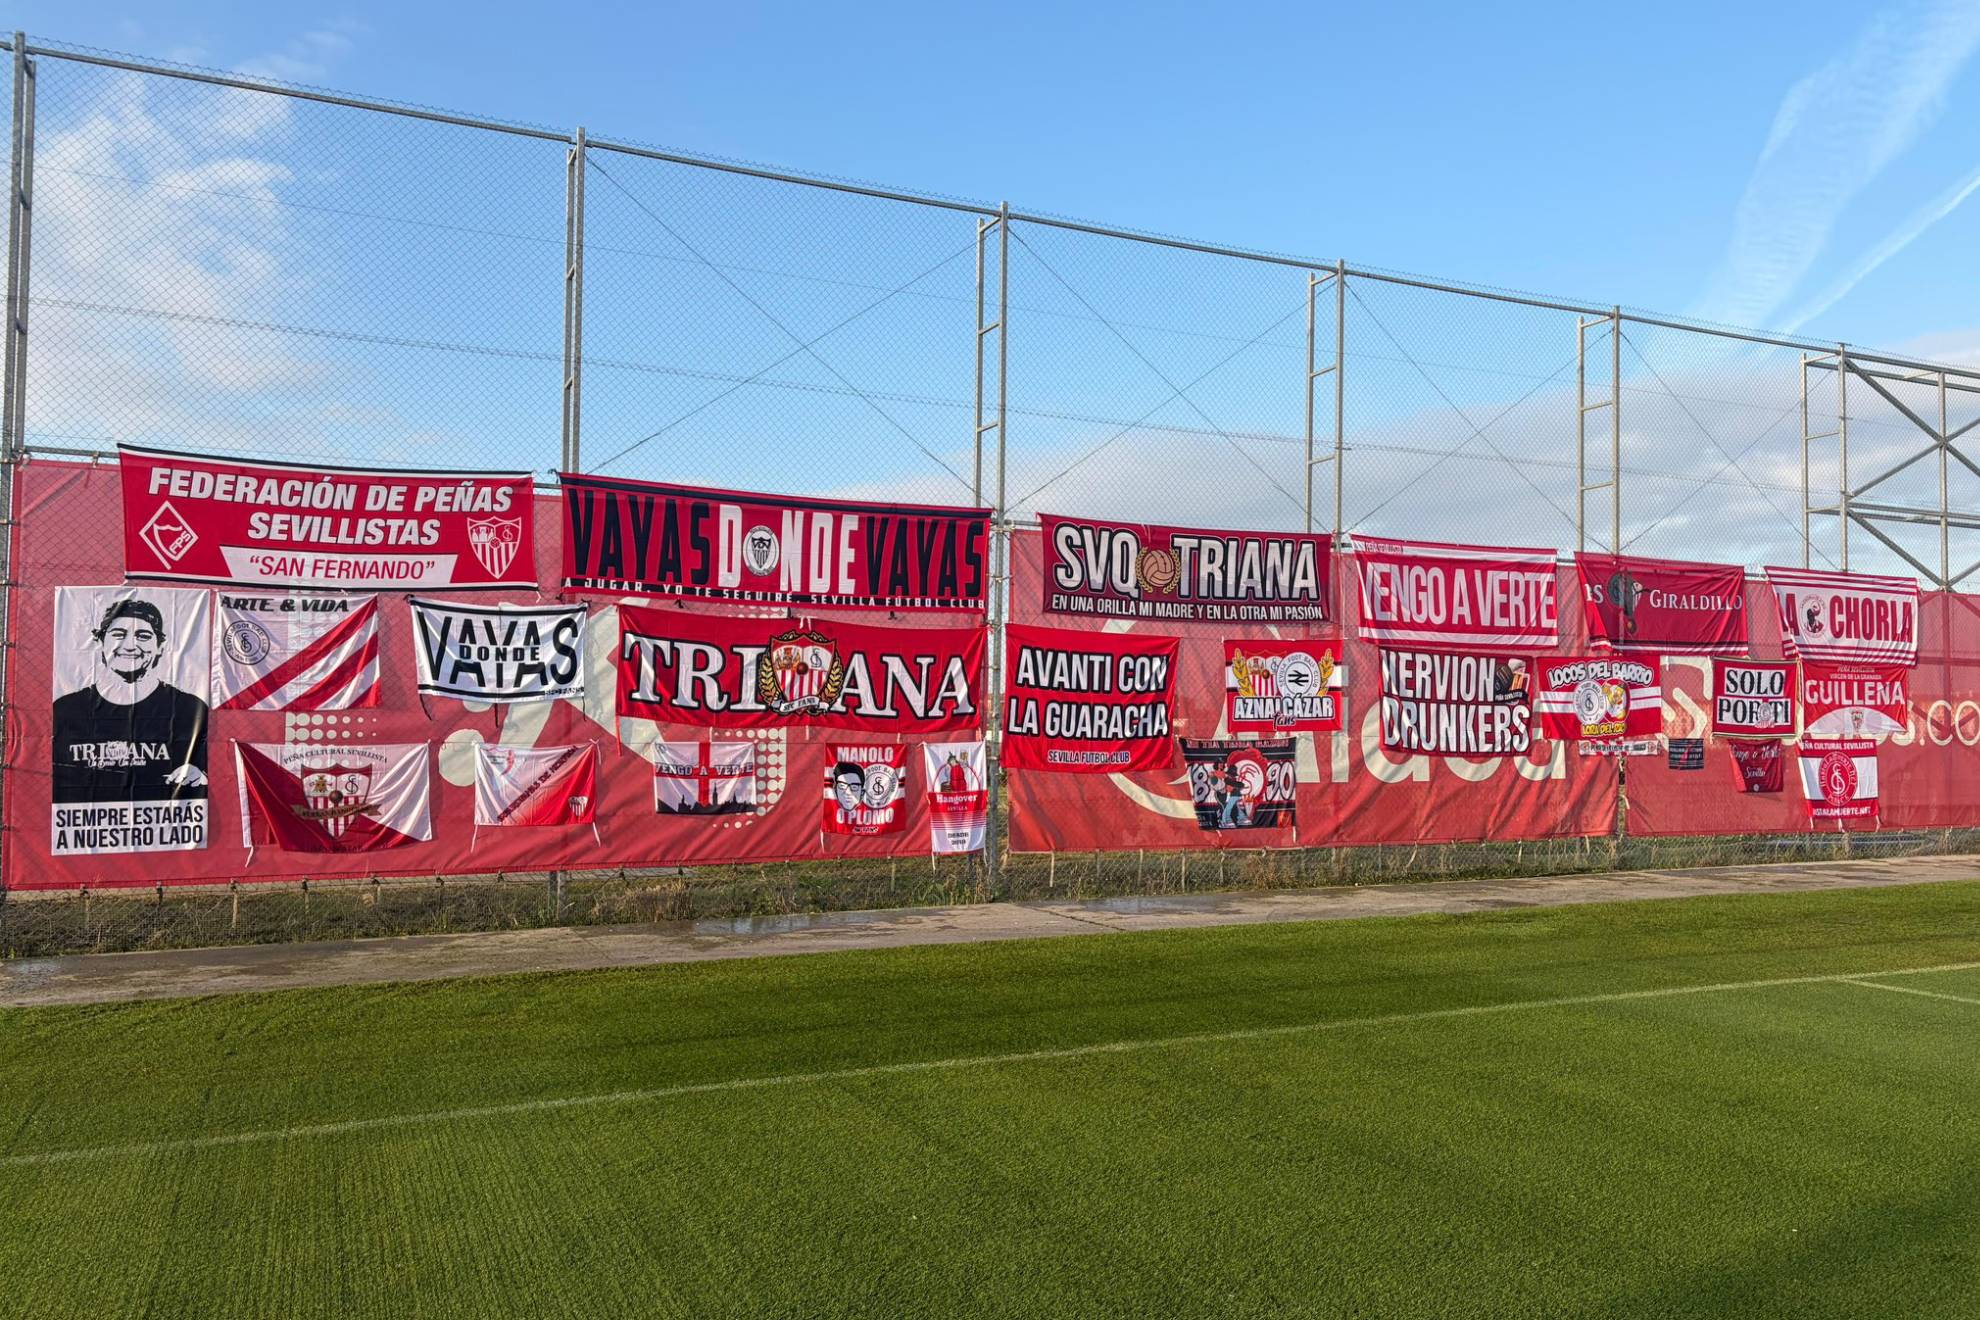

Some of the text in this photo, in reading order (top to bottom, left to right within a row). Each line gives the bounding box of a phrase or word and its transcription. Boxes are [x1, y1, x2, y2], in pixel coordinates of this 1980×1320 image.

[148, 467, 513, 512] FEDERACIÓN DE PEÑAS
[248, 512, 440, 545] SEVILLISTAS
[169, 530, 192, 554] FPS
[567, 488, 710, 585] VAYAS
[866, 514, 984, 597] VAYAS
[1056, 525, 1319, 599] SVQ TRIANA
[221, 596, 349, 613] ARTE & VIDA
[564, 578, 572, 587] A
[663, 584, 683, 595] YO
[695, 587, 712, 597] TE
[811, 594, 876, 606] SEVILLA
[950, 598, 985, 609] CLUB
[1356, 560, 1557, 629] VENGO A VERTE
[1052, 594, 1323, 620] EN UNA ORILLA MI MADRE Y EN LA OTRA MI PASIÓN
[1829, 595, 1913, 643] CHORLA
[459, 644, 541, 662] DONDE
[623, 632, 976, 718] TRIANA
[1017, 648, 1169, 692] AVANTI CON
[1380, 649, 1496, 702] NERVION
[1548, 660, 1653, 688] LOCOS DEL BARRIO
[1726, 669, 1784, 695] SOLO
[1805, 680, 1905, 706] GUILLENA
[1008, 698, 1169, 739] LA GUARACHA
[1718, 698, 1760, 723] POR
[1771, 700, 1789, 723] TI
[1383, 696, 1530, 753] DRUNKERS
[1600, 722, 1613, 735] DEL
[69, 742, 171, 761] TRIANA
[284, 748, 388, 765] PEÑA CULTURAL SEVILLISTA
[837, 746, 894, 763] MANOLO
[1048, 750, 1080, 763] SEVILLA
[1111, 751, 1131, 764] CLUB
[1814, 742, 1842, 750] CULTURAL
[1843, 741, 1875, 750] SEVILLISTA
[655, 762, 754, 776] VENGO A VERTE
[1265, 760, 1296, 802] 90
[936, 793, 978, 805] Hangover
[56, 802, 204, 828] SIEMPRE ESTARÁS
[836, 807, 895, 825] O PLOMO
[56, 825, 203, 850] A NUESTRO LADO
